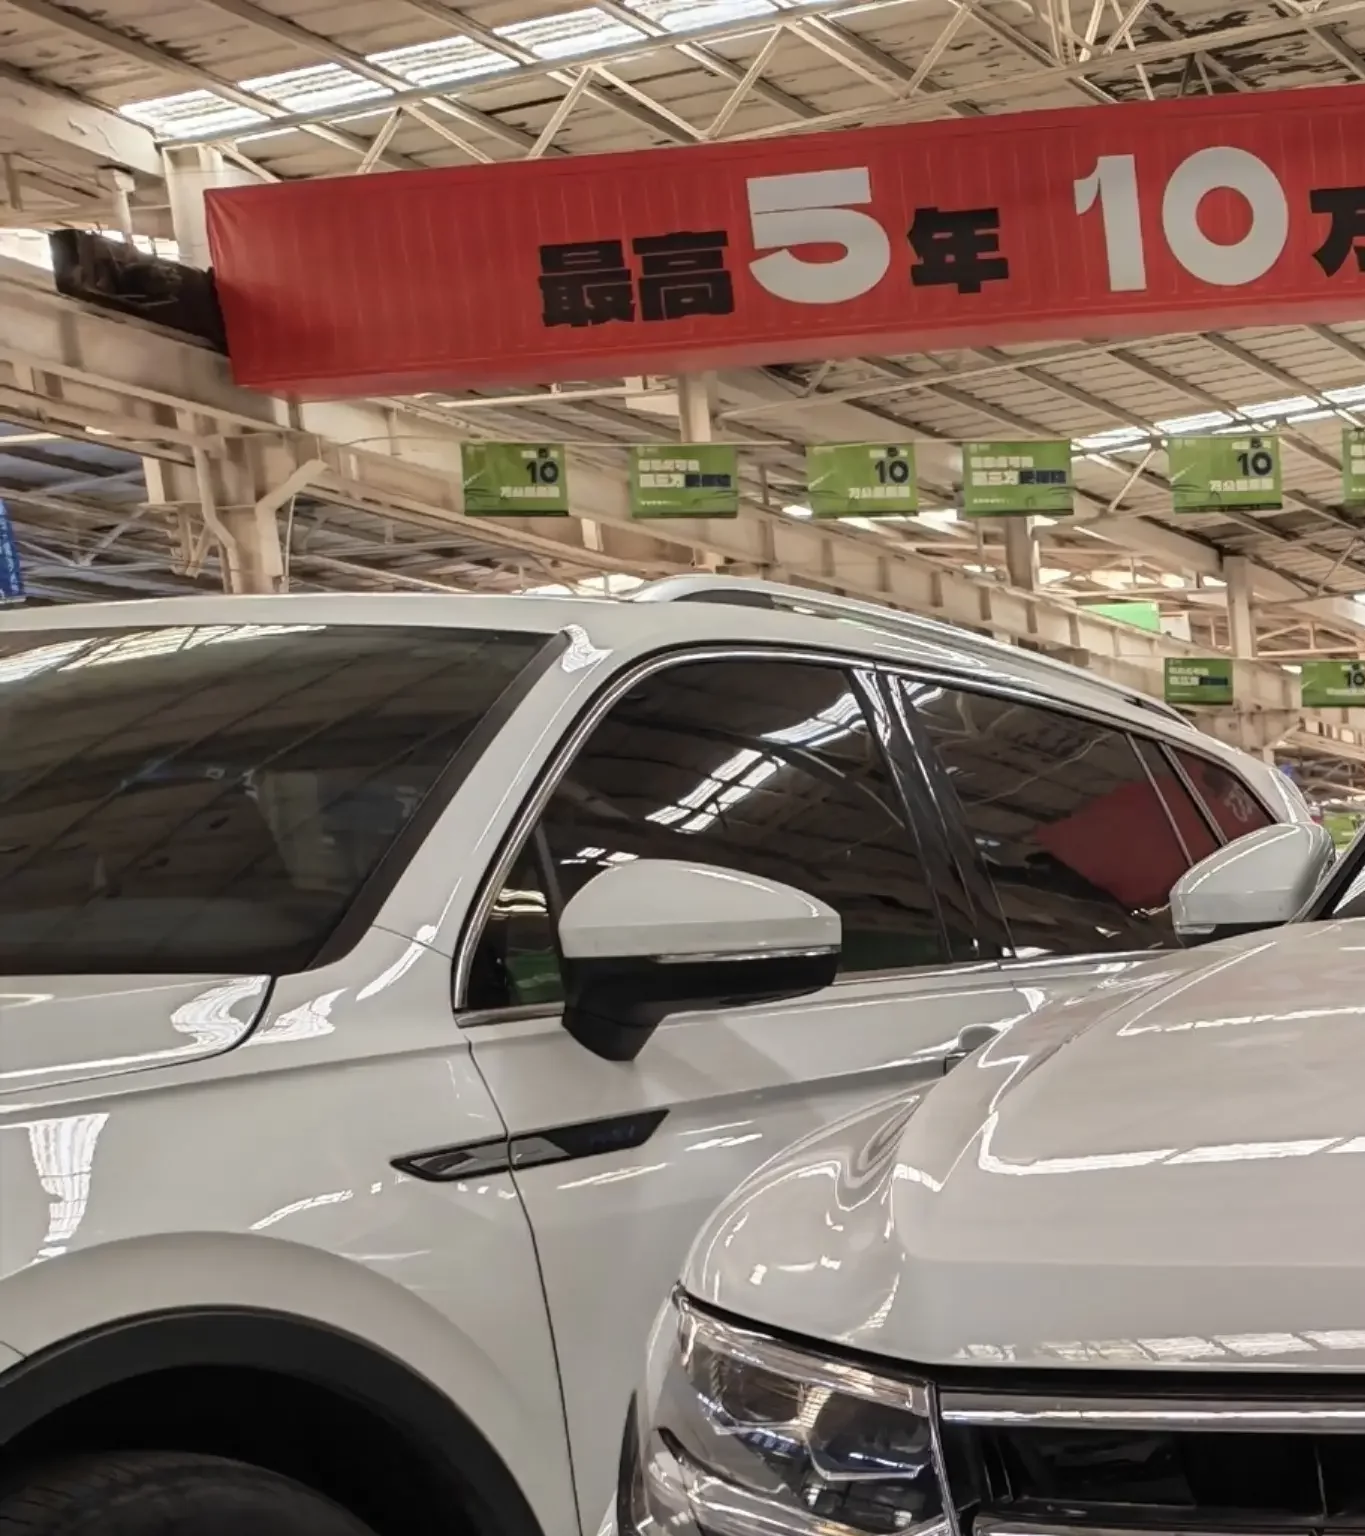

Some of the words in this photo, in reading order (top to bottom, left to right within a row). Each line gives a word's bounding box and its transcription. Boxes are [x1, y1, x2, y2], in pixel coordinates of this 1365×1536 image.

[526, 461, 559, 484] 10
[875, 461, 909, 484] 10
[1237, 452, 1272, 476] 10
